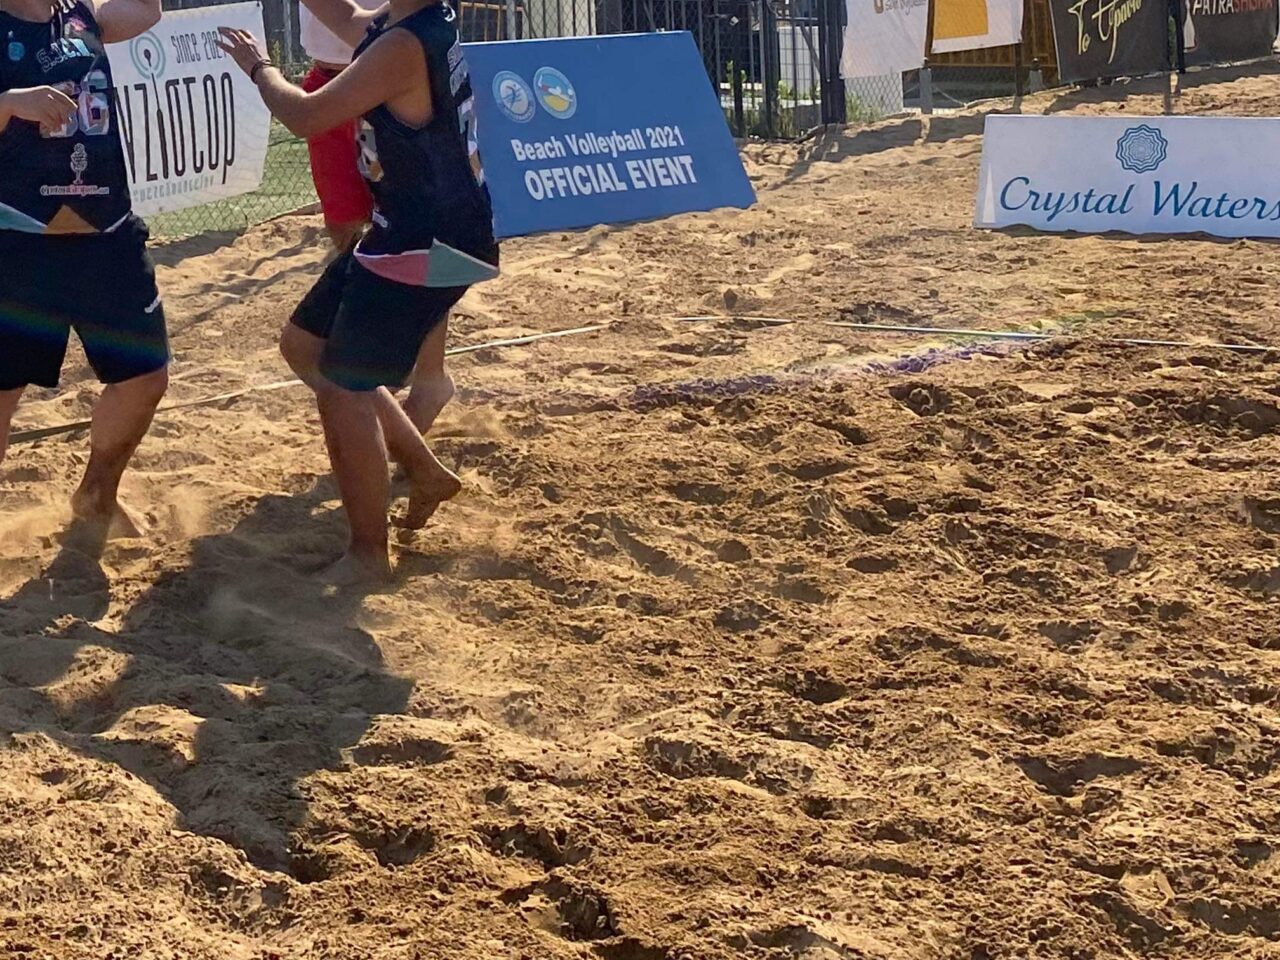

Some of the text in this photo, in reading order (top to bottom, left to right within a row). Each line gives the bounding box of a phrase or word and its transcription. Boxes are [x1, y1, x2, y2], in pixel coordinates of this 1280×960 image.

[511, 125, 685, 162] Beach Volleyball 2021
[524, 155, 697, 200] OFFICIAL EVENT
[1000, 176, 1280, 222] Crystal Waters
